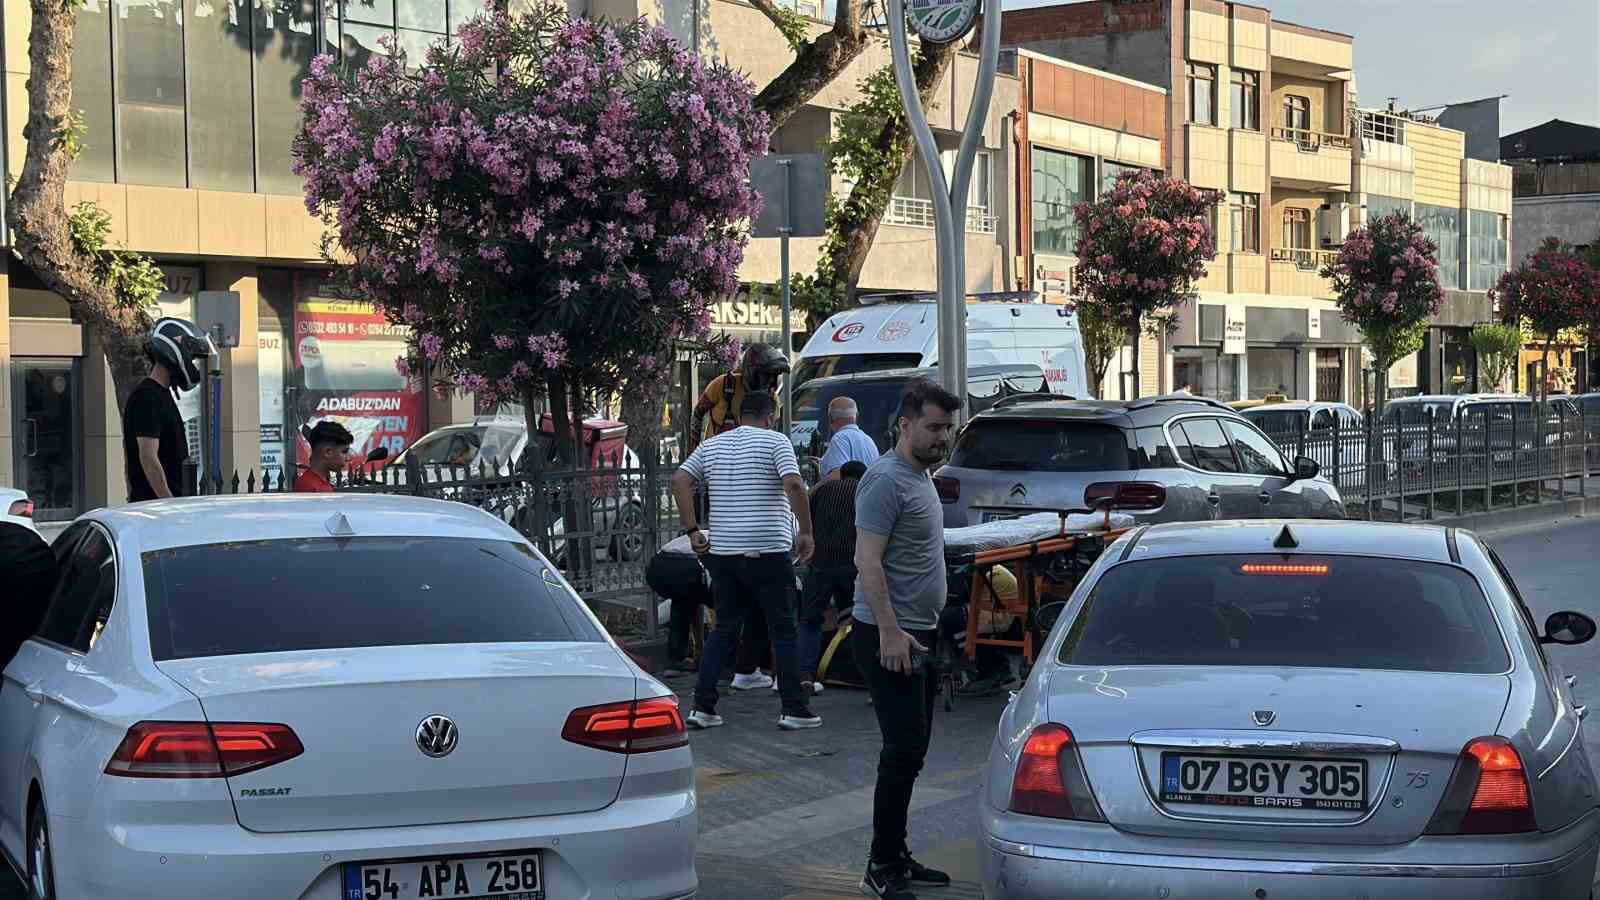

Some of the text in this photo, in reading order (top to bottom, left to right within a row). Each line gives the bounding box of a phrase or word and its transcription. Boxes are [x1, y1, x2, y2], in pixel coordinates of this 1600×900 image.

[317, 398, 401, 411] ADABUZ'DAN
[1166, 760, 1360, 797] TR 07 BGY 305
[240, 787, 292, 797] PASSAT
[1254, 797, 1303, 807] BARIS
[349, 858, 538, 900] TR 54 APA 258
